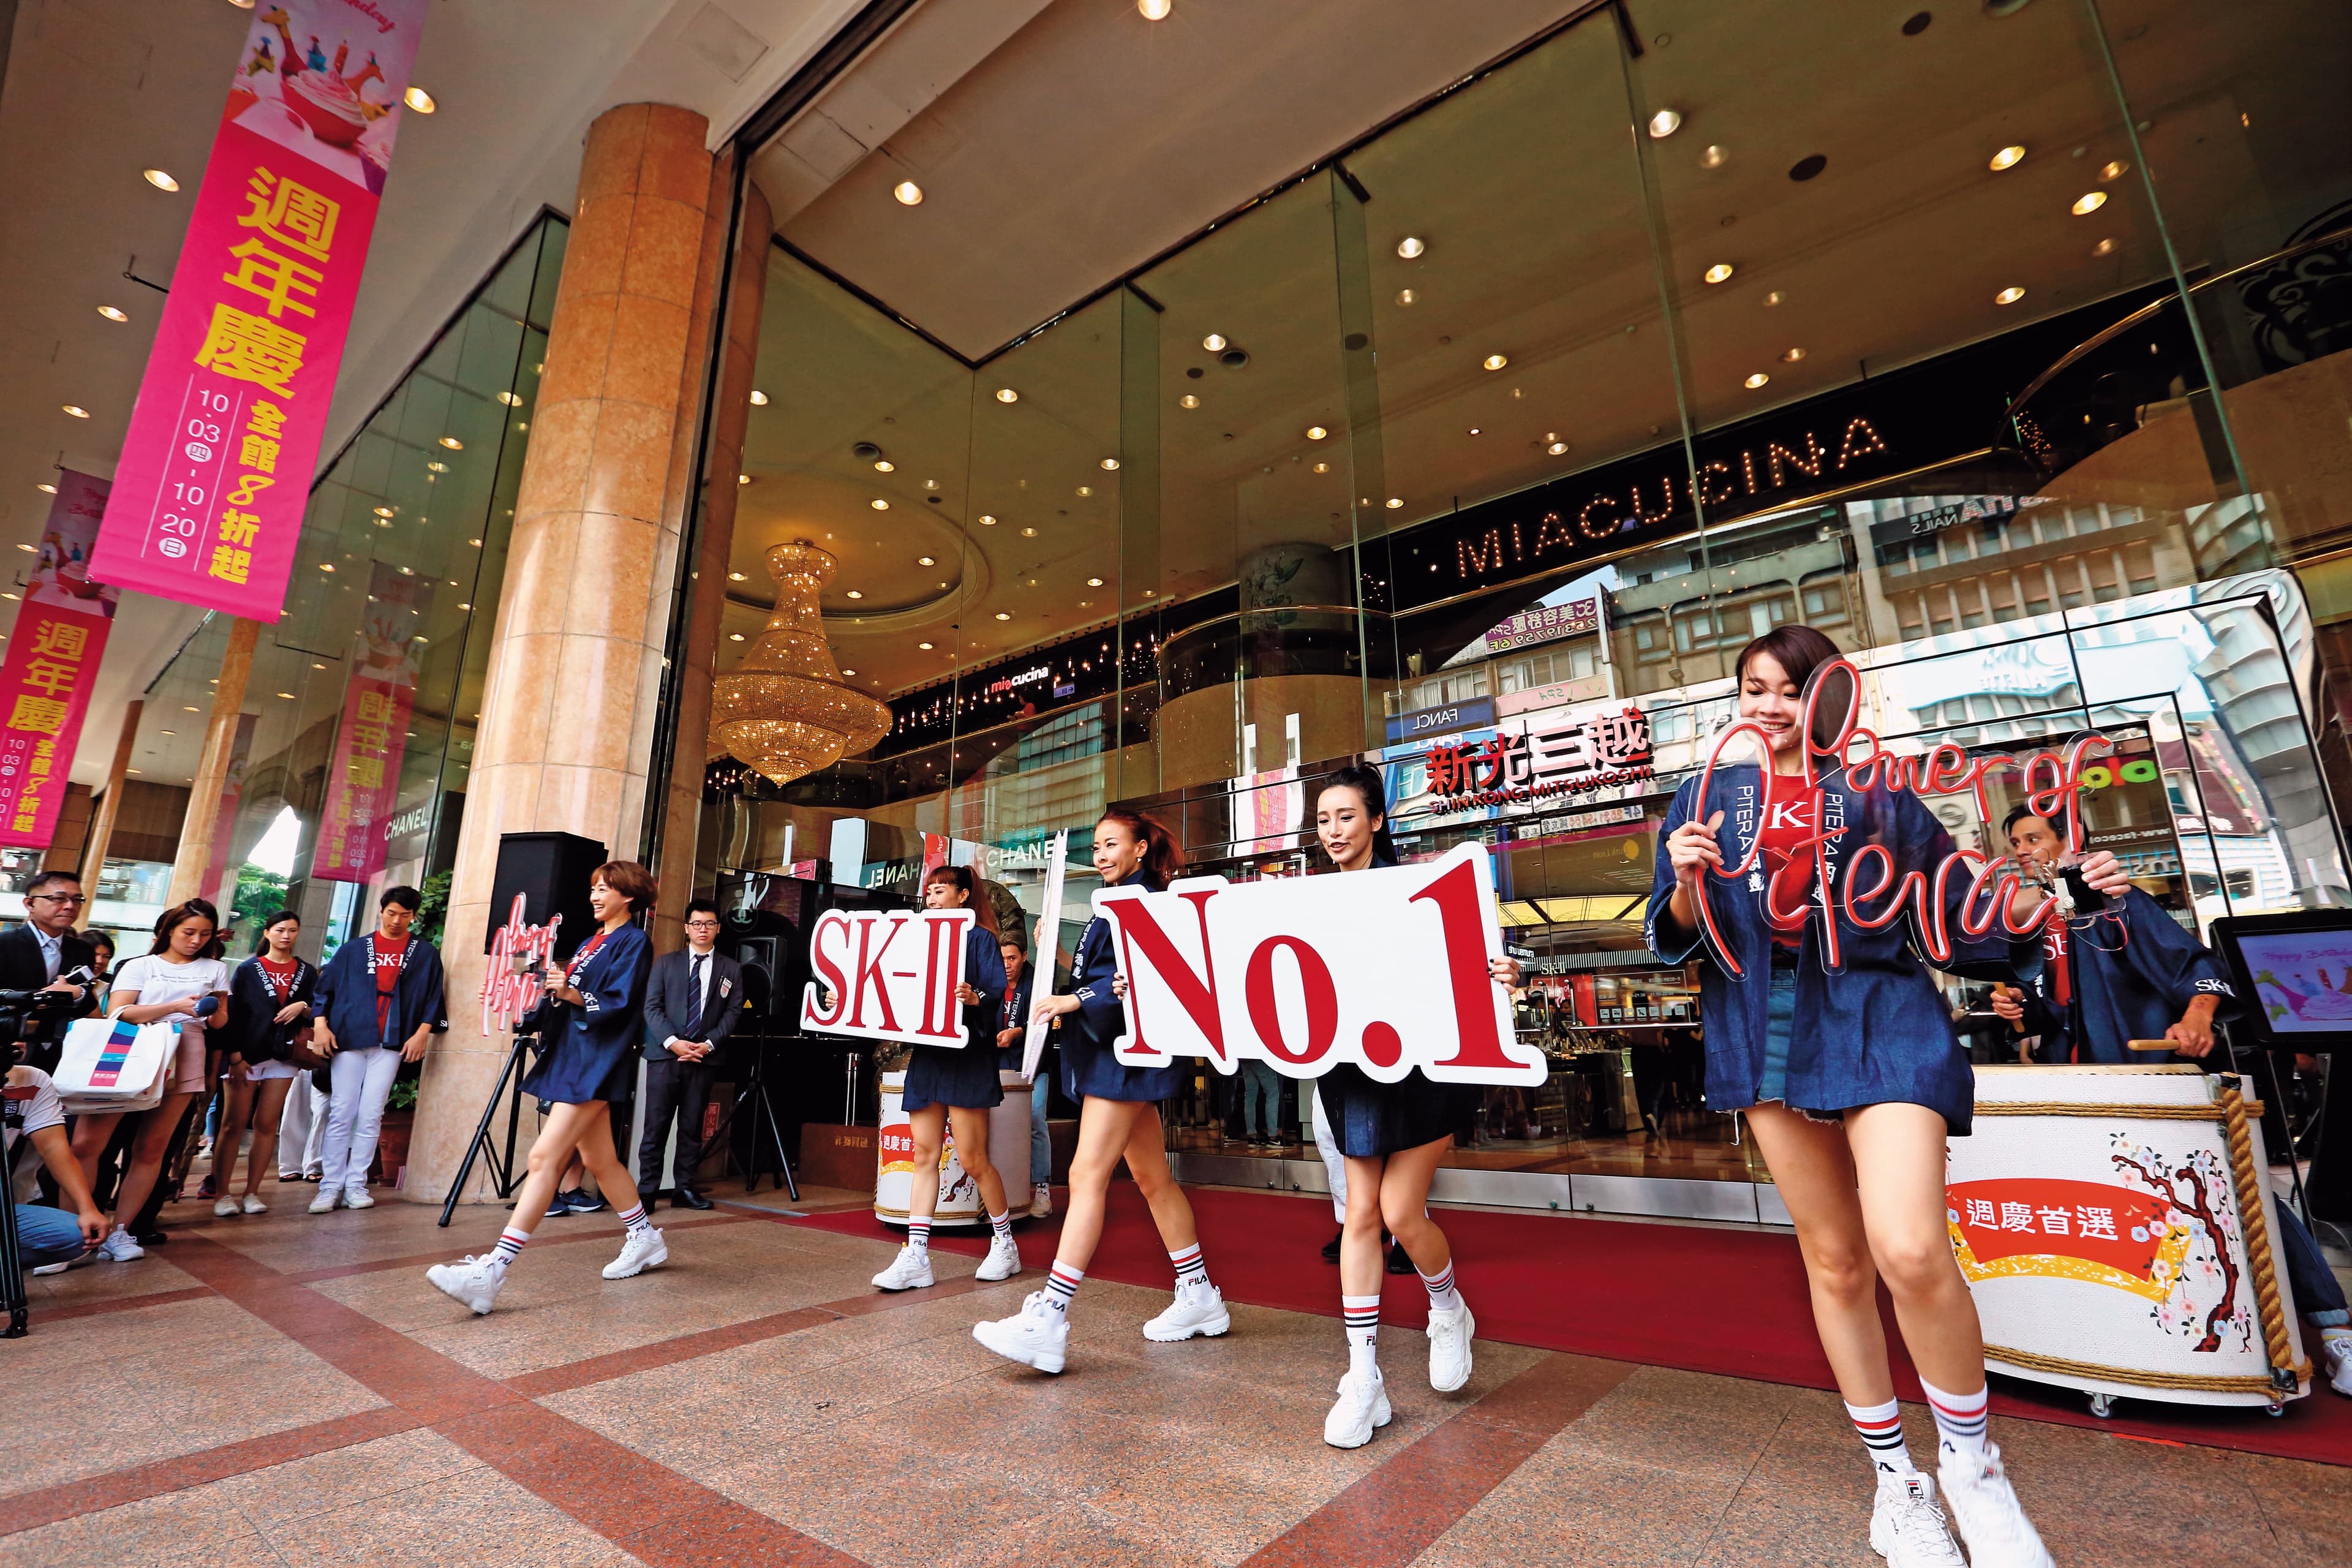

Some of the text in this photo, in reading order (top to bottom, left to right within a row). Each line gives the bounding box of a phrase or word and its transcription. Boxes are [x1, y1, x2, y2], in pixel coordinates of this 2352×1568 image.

[194, 166, 340, 399] 週年慶
[208, 399, 287, 585] 全館8折起
[1457, 418, 1885, 578] MIACUCINA
[6, 619, 88, 737] 週年慶
[1425, 707, 1649, 795] 新光三越
[1429, 765, 1651, 813] SHIN KONG MITSUKOSHI
[384, 807, 428, 842] CHANEL
[1736, 785, 1754, 851] PITERA
[1100, 858, 1531, 1069] No.1
[1508, 944, 1534, 959] shu uemura
[581, 990, 600, 1012] SK-II
[804, 916, 968, 1039] SK-II
[1009, 992, 1021, 1020] PITERA
[636, 1221, 650, 1233] FILA
[1964, 1199, 2119, 1241] 週慶首選
[1188, 1274, 1208, 1286] FILA
[1046, 1297, 1065, 1312] FILA
